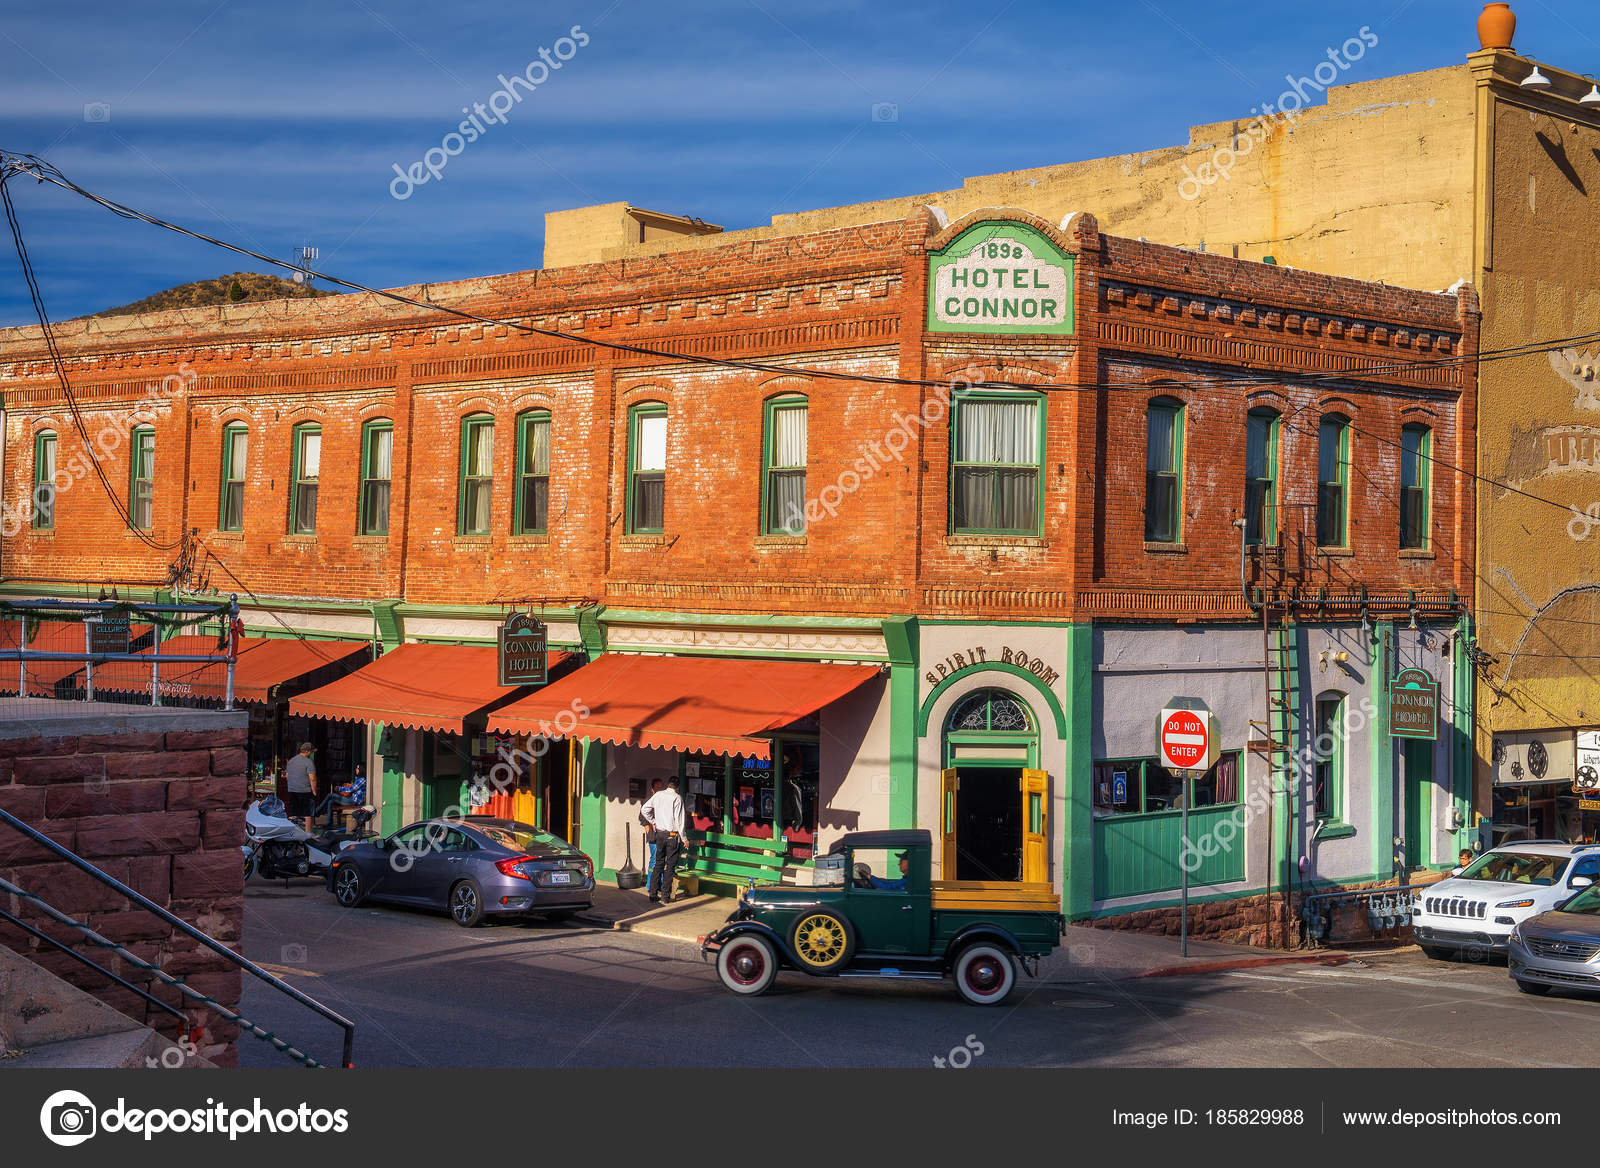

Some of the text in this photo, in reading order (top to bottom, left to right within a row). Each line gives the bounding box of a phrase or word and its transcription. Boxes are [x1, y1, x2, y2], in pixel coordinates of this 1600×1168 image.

[981, 243, 1023, 260] 1898
[952, 268, 1049, 289] HOTEL
[945, 297, 1057, 318] CONNOR
[504, 641, 546, 654] CONNOR
[509, 657, 543, 671] HOTEL
[925, 646, 1060, 688] SPIRIT ROOM
[1395, 711, 1431, 725] HOTEL
[1168, 721, 1201, 733] DO NOT
[1171, 746, 1198, 758] ENTER
